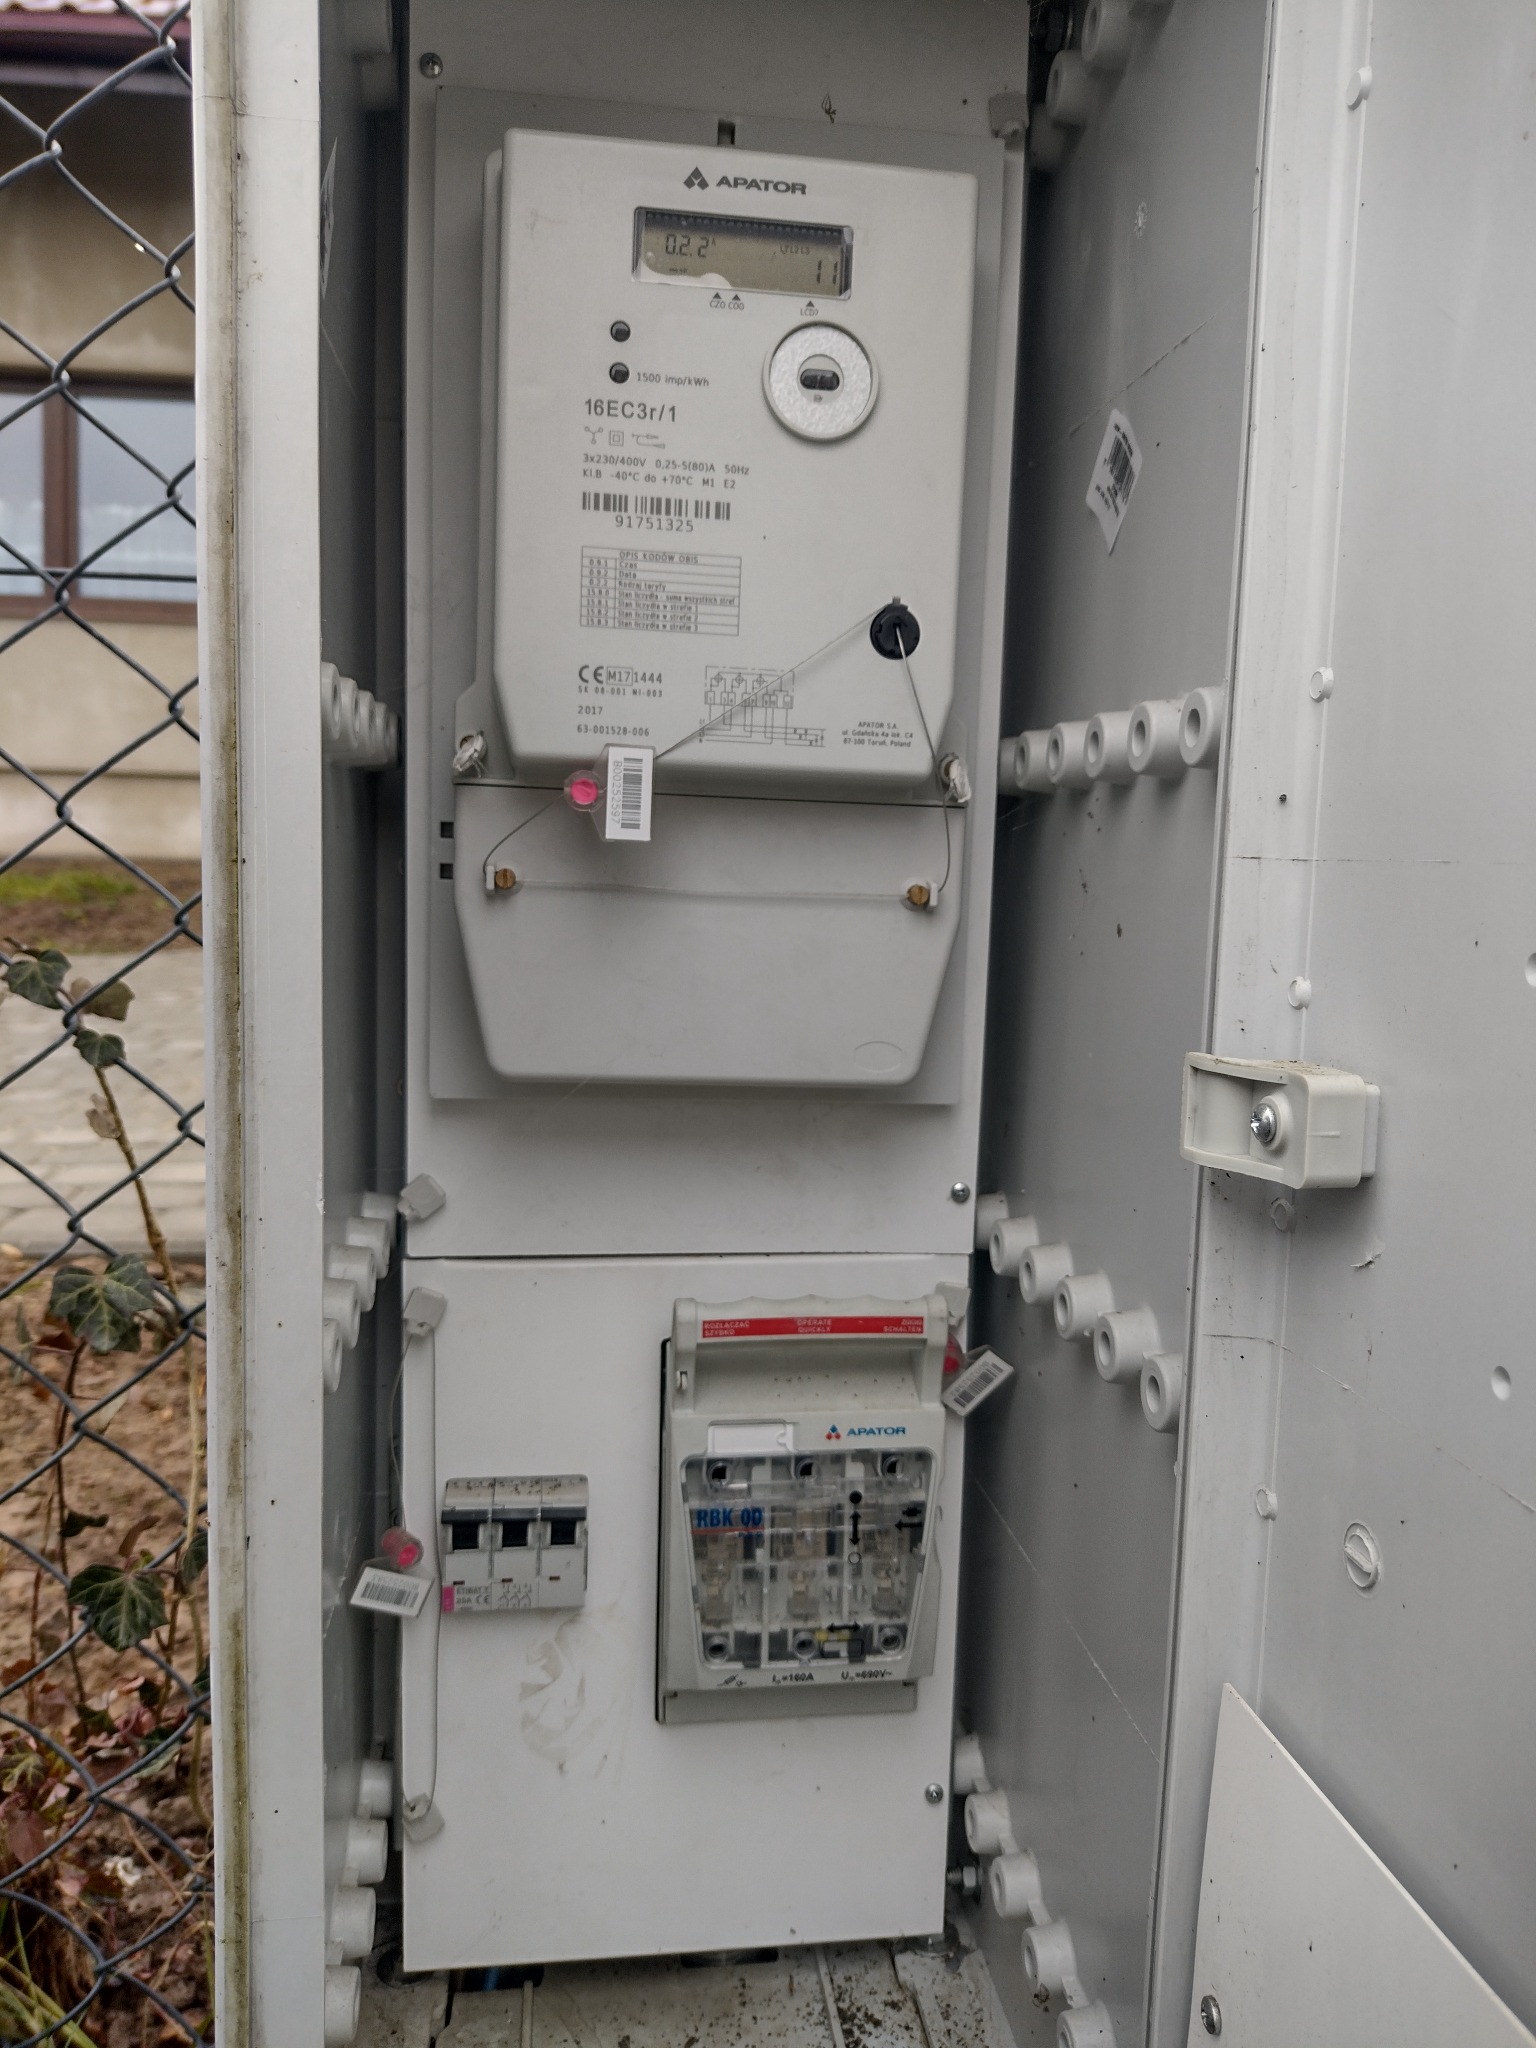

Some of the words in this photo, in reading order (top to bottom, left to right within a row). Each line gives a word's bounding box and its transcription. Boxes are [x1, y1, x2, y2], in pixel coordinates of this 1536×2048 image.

[716, 175, 807, 196] APATOR
[636, 372, 661, 384] 1500
[664, 374, 710, 388] imp/kWh
[584, 398, 676, 422] 16EC3r/1
[582, 453, 647, 468] 3x230/400V
[724, 465, 750, 476] 50Hz
[610, 471, 640, 482] -40°C
[644, 473, 657, 483] do
[661, 475, 694, 486] +70°C
[702, 477, 715, 488] M1
[723, 479, 736, 489] E2
[614, 514, 695, 533] 91751325
[619, 551, 639, 560] OPIS
[608, 670, 631, 683] M17
[634, 671, 663, 684] 1444
[577, 705, 603, 715] 2017
[577, 724, 650, 737] 63-001528-006
[858, 721, 884, 729] APATOR
[846, 1426, 906, 1436] APATOR
[695, 1507, 735, 1527] RBK
